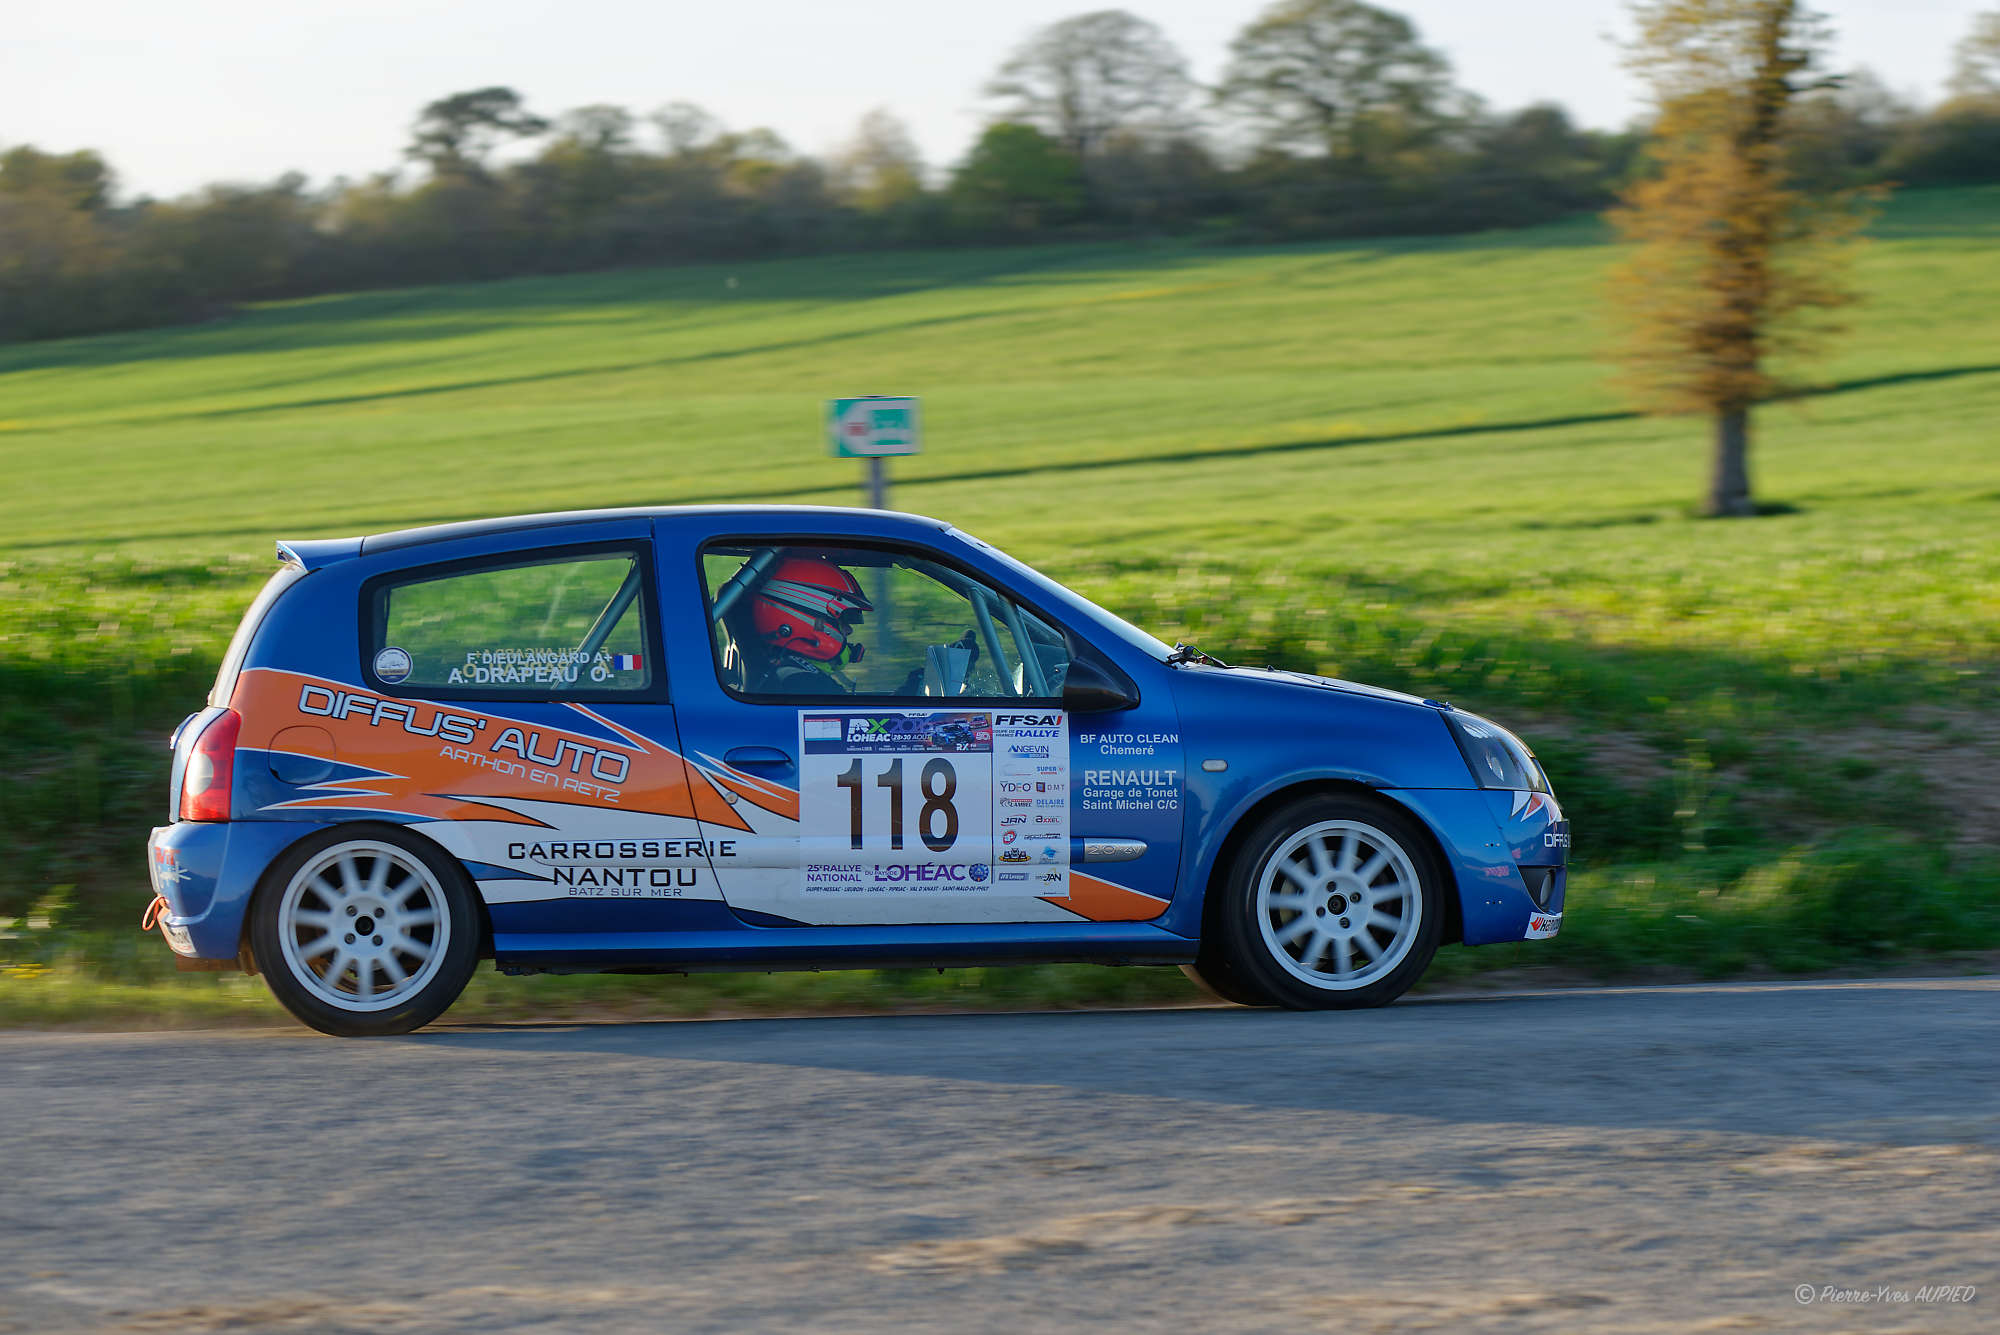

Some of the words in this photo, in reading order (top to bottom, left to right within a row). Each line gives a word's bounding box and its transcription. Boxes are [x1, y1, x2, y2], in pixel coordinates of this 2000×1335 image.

[466, 652, 478, 664] F.
[482, 652, 590, 664] DIEULANGARD
[593, 652, 613, 664] A+
[447, 667, 469, 684] A.
[475, 666, 578, 683] DRAPEAU
[995, 715, 1055, 725] FFSA
[298, 684, 487, 745] DIFFUS'
[490, 727, 631, 785] AUTO
[847, 733, 892, 743] LOHEAC
[1015, 729, 1060, 738] RALLYE
[1080, 734, 1096, 744] BF
[1100, 734, 1133, 744] AUTO
[1137, 734, 1179, 744] CLEAN
[1008, 744, 1049, 753] ANGEVIN
[1100, 745, 1155, 755] Chemeré
[440, 745, 526, 775] ARTHON
[529, 769, 560, 787] EN
[563, 778, 622, 803] RETZ
[1084, 770, 1177, 786] RENAULT
[1083, 788, 1124, 800] Garage
[1128, 787, 1142, 798] de
[1146, 788, 1179, 798] Tonet
[837, 757, 959, 852] 118
[1082, 800, 1113, 810] Saint
[1116, 800, 1154, 810] Michel
[1157, 800, 1178, 810] C/C
[508, 841, 737, 860] CARROSSERIE
[823, 864, 862, 872] RALLYE
[874, 861, 967, 882] LOHÉAC
[553, 867, 697, 887] NANTOU
[807, 873, 862, 882] NATIONAL
[568, 887, 604, 897] BATZ
[610, 888, 642, 897] SUR
[651, 888, 682, 897] MER
